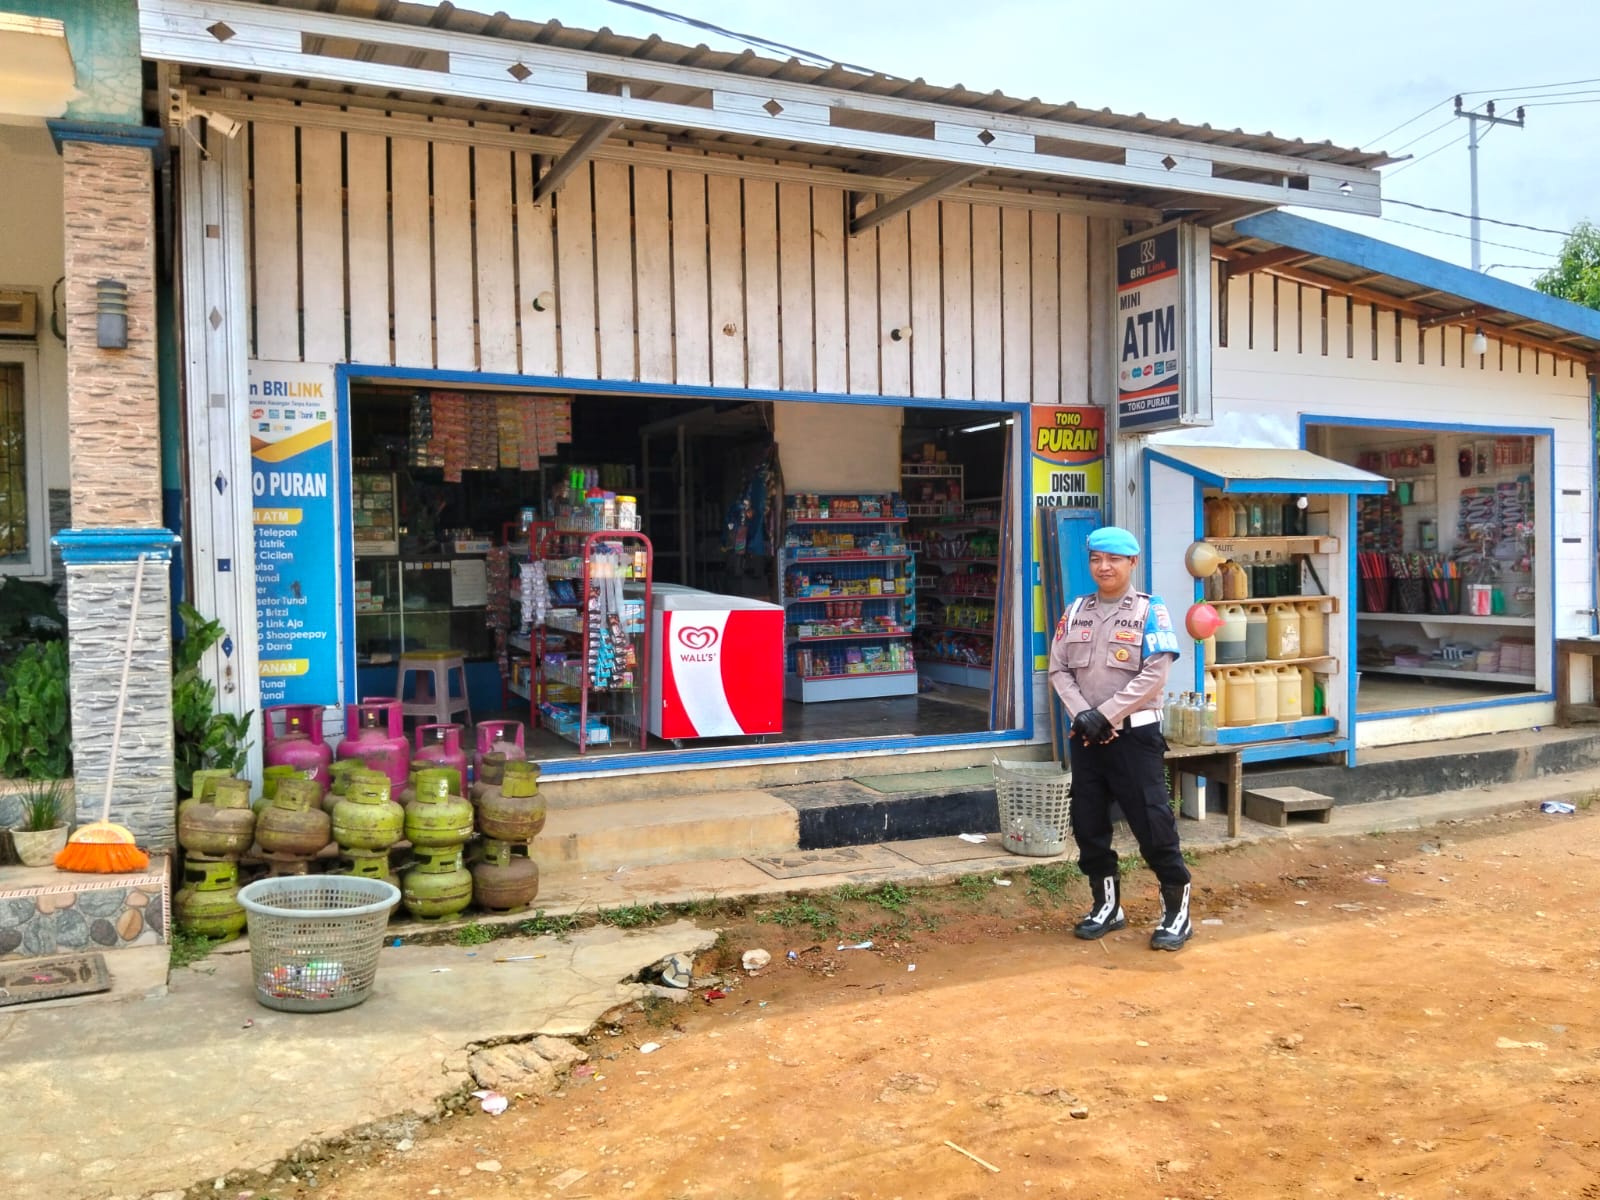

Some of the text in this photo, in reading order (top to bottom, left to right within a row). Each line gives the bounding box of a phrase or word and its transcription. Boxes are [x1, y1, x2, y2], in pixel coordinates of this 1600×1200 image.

[1130, 265, 1145, 279] BRI
[1120, 291, 1141, 310] MINI
[1122, 304, 1175, 362] ATM
[263, 380, 324, 398] BRILINK
[1127, 396, 1170, 412] TOKO PURAN
[1055, 412, 1081, 426] TOKO
[1037, 427, 1099, 453] PURAN
[269, 471, 327, 497] PURAN
[1052, 473, 1085, 492] DISINI
[263, 511, 289, 522] ATM
[259, 528, 298, 538] Telepon
[259, 539, 286, 549] Listrik
[260, 551, 294, 560] Cicilan
[282, 595, 308, 606] Tunai
[266, 608, 289, 617] Brizzi
[266, 619, 285, 628] Link
[1114, 619, 1143, 629] POLRI
[266, 631, 327, 640] Shoopeepay
[266, 643, 293, 651] Dana
[680, 653, 713, 662] WALL'S
[261, 680, 286, 689] Tunai
